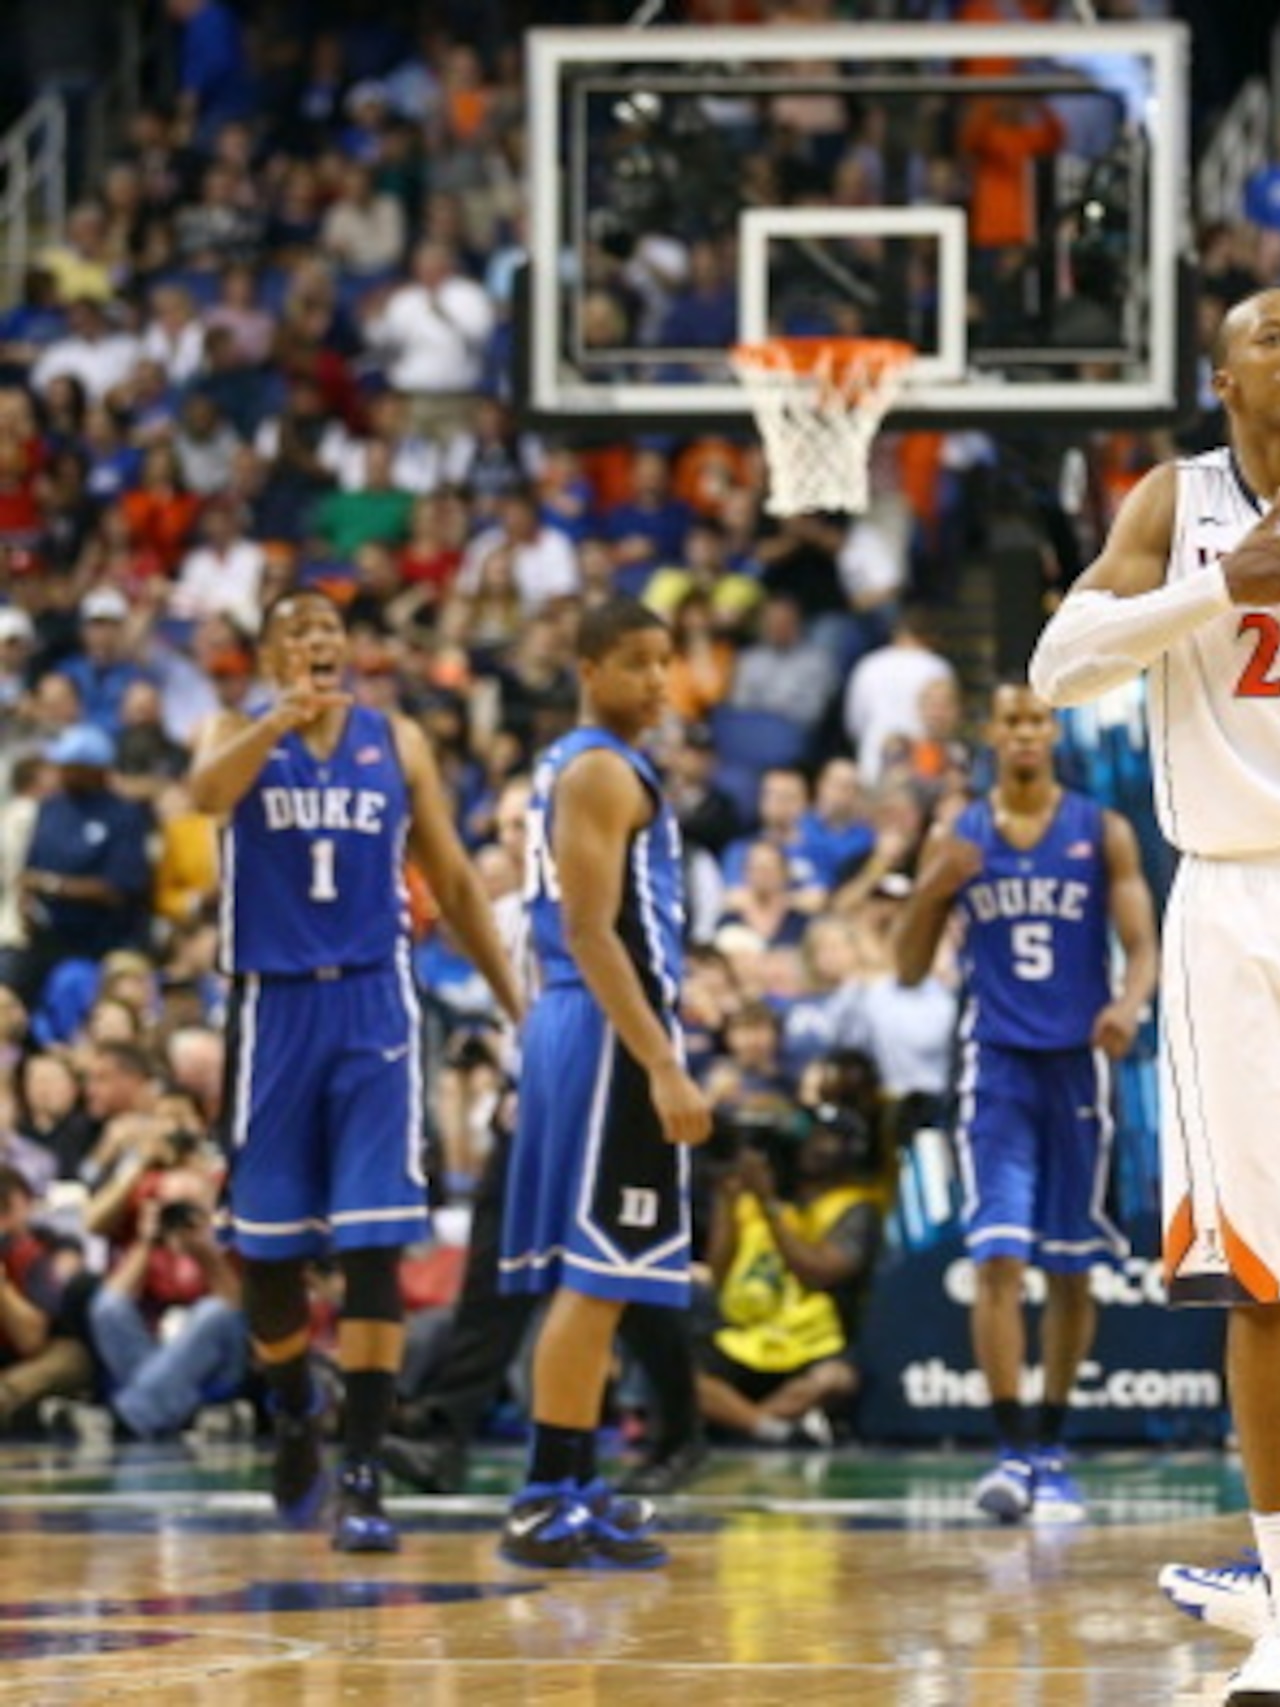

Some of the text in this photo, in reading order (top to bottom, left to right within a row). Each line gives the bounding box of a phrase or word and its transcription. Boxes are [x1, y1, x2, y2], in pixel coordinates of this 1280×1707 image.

[262, 785, 388, 835] DUKE
[309, 838, 338, 902] 1
[969, 877, 1089, 922] DUKE
[1012, 921, 1053, 981] 5
[618, 1186, 659, 1227] D
